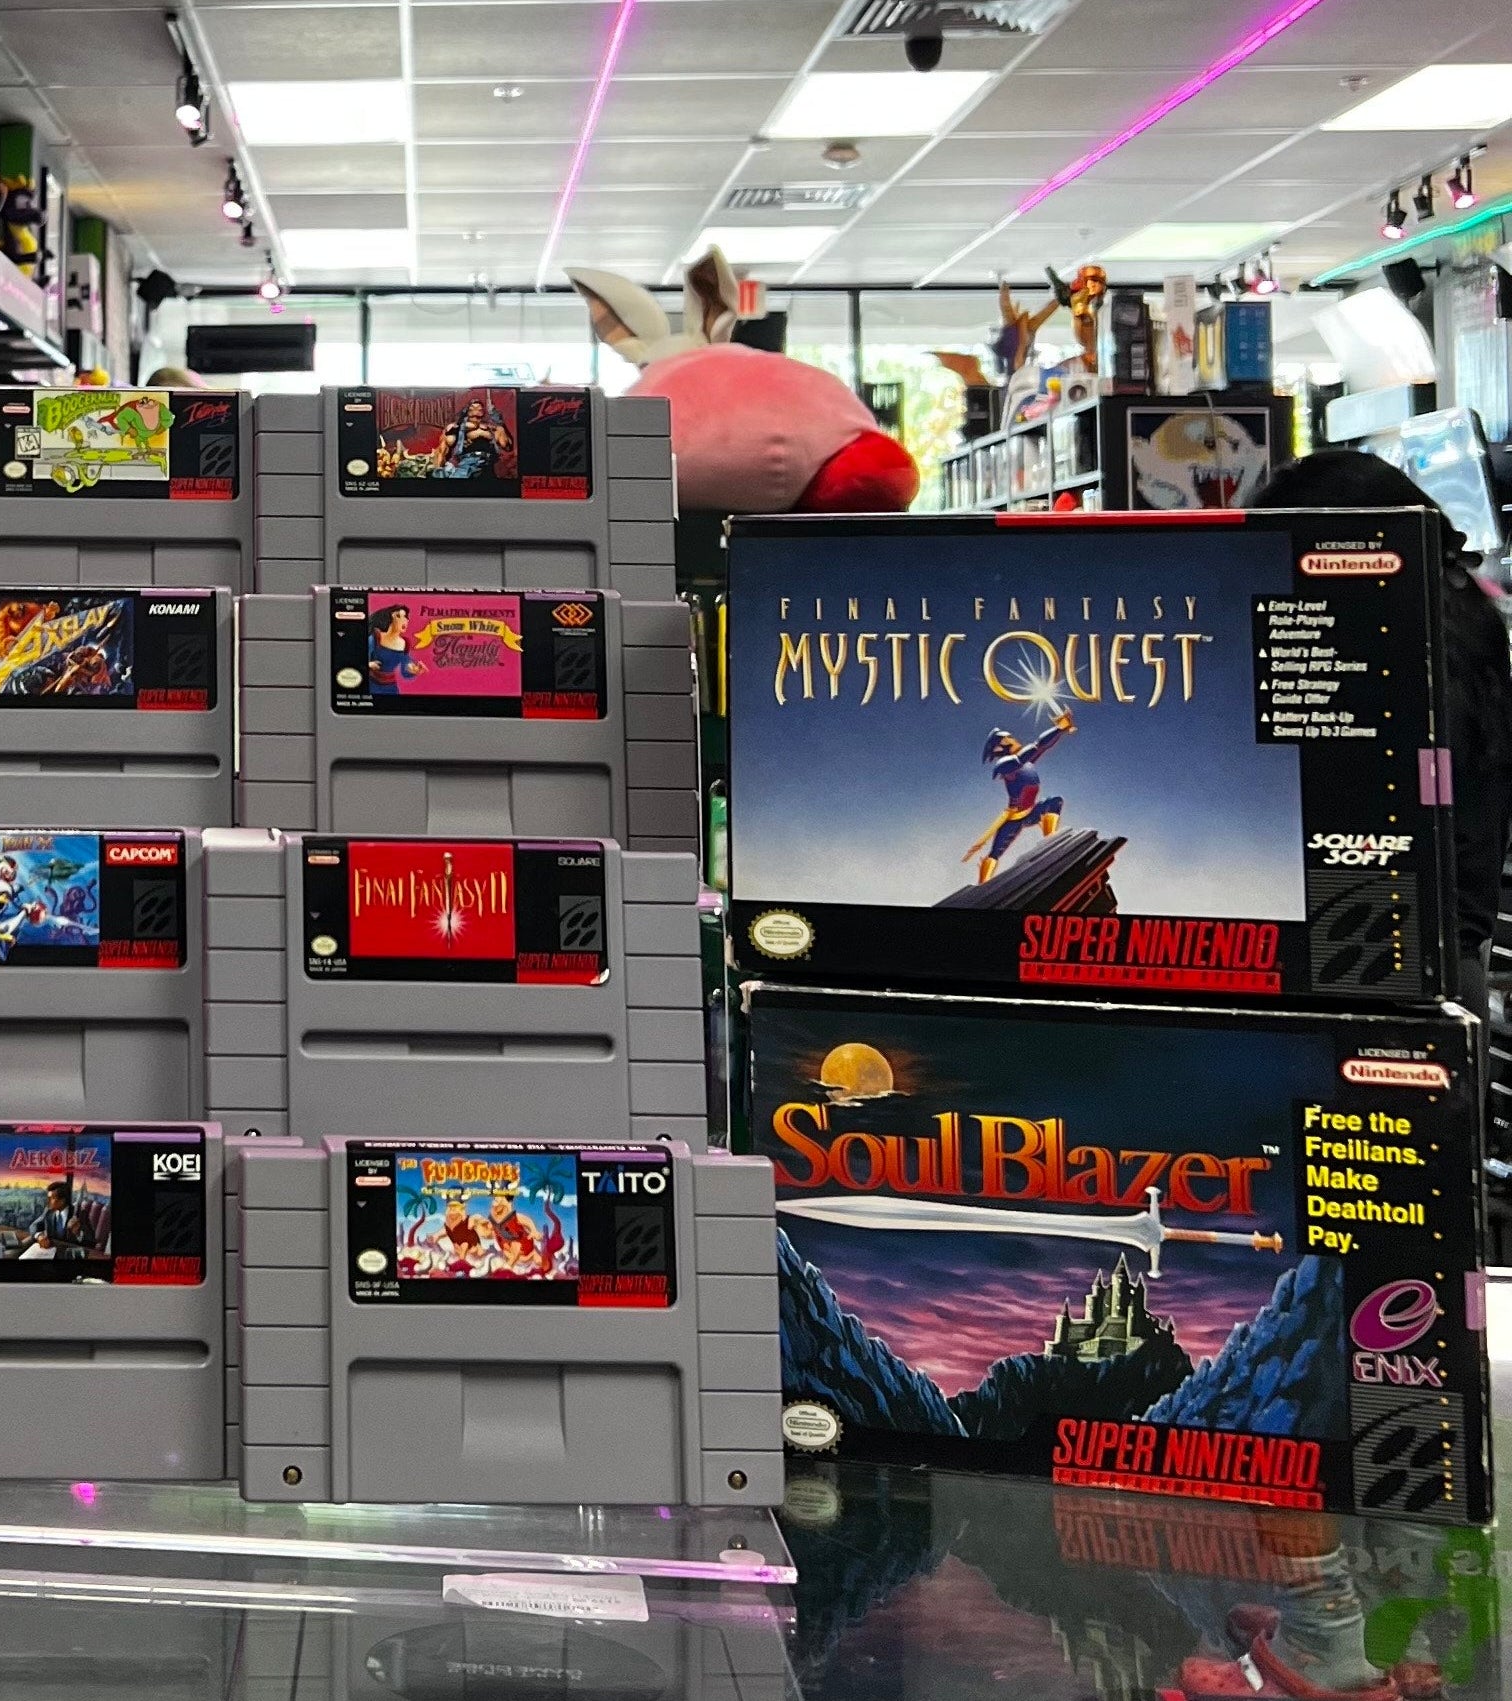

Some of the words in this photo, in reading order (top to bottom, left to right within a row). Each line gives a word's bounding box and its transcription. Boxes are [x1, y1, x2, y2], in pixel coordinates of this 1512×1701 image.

[1316, 541, 1366, 550] LICENSED
[1368, 541, 1382, 550] BY
[1308, 557, 1395, 570] Nintendo
[149, 603, 200, 615] KONAMI
[471, 609, 516, 618] PRESENTS
[779, 597, 932, 621] FINAL
[974, 596, 1197, 621] FANTASY
[1269, 601, 1327, 613] Entry-Level
[436, 621, 465, 632] Snow
[469, 621, 500, 632] White
[1269, 615, 1335, 627] Role-Playing
[1269, 629, 1322, 640] Adventure
[1271, 646, 1309, 657] World's
[773, 631, 968, 706] MYSTIC
[982, 630, 1202, 709] QUEST
[1271, 661, 1307, 674] Selling
[1309, 661, 1332, 672] RPG
[1334, 661, 1368, 673] Series
[1272, 679, 1295, 690] Free
[1297, 680, 1341, 692] Strategy
[1272, 693, 1303, 704] Guide
[1304, 693, 1331, 704] Offer
[1273, 711, 1309, 724] Battery
[1273, 726, 1303, 737] Saves
[1305, 726, 1320, 739] Up
[1340, 726, 1377, 737] Games
[1307, 833, 1414, 852] SQUARE
[109, 847, 172, 861] CAPCOM
[557, 856, 601, 867] SQUARE
[1323, 850, 1394, 867] SOFT
[354, 868, 404, 918] FINAL
[410, 870, 487, 918] FANTASY
[490, 871, 508, 914] II
[1020, 915, 1121, 962] SUPER
[1127, 920, 1279, 970] NINTENDO
[1358, 1048, 1410, 1059] LICENSED
[1413, 1050, 1428, 1060] BY
[1349, 1064, 1441, 1081] Nintendo
[1304, 1106, 1363, 1131] Free
[1369, 1112, 1412, 1135] the
[9, 1147, 101, 1170] AEROBIZ
[772, 1102, 961, 1195] Soul
[969, 1114, 1273, 1216] Blazer
[1305, 1136, 1426, 1166] Freilians.
[153, 1153, 201, 1173] KOEI
[420, 1157, 522, 1185] FLINTSTONES
[581, 1165, 667, 1194] TAITO
[1306, 1164, 1380, 1192] Make
[1307, 1195, 1426, 1226] Deathtoll
[1308, 1225, 1360, 1254] Pay.
[114, 1256, 149, 1273] SUPER
[150, 1257, 201, 1275] NINTENDO
[577, 1275, 614, 1293] SUPER
[615, 1276, 668, 1295] NINTENDO
[1352, 1352, 1444, 1388] ENIX
[1053, 1418, 1156, 1474] SUPER
[1163, 1428, 1321, 1489] NINTENDO
